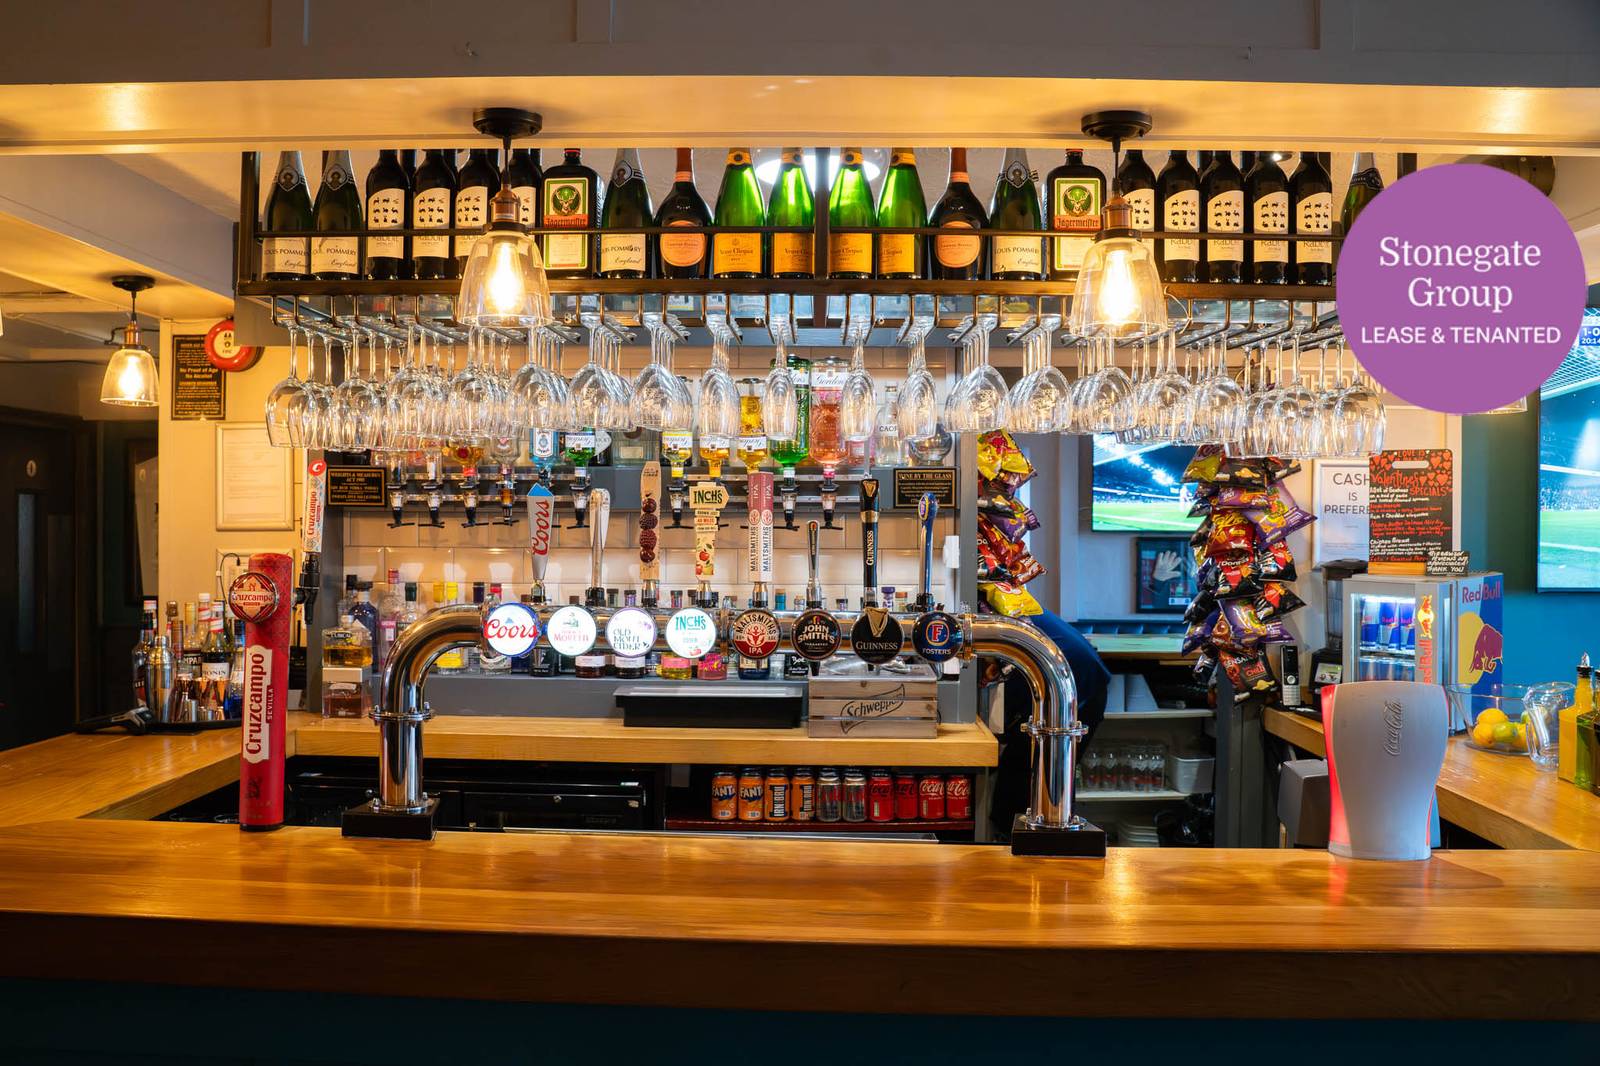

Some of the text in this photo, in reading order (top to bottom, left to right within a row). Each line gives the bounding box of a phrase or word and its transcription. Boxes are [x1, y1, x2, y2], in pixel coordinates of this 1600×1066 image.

[1348, 491, 1358, 501] IS
[306, 491, 318, 536] Cruzcampo
[531, 499, 550, 556] Coors
[866, 530, 874, 566] GUINNESS
[1427, 565, 1448, 573] THANK
[231, 590, 273, 603] Cruzcampo
[1461, 581, 1501, 604] Red Bull
[483, 618, 538, 639] Coors
[674, 615, 706, 631] INCH'S
[735, 613, 777, 635] MALTSMITHS
[802, 623, 829, 634] JOHN
[613, 628, 631, 636] OLD
[798, 631, 836, 644] SMITH'S
[931, 624, 944, 642] F
[613, 642, 641, 651] CIDER
[748, 646, 763, 655] IPA
[855, 641, 898, 650] GUINNESS
[1418, 640, 1432, 685] ed Bull
[246, 651, 267, 756] Cruzcampo
